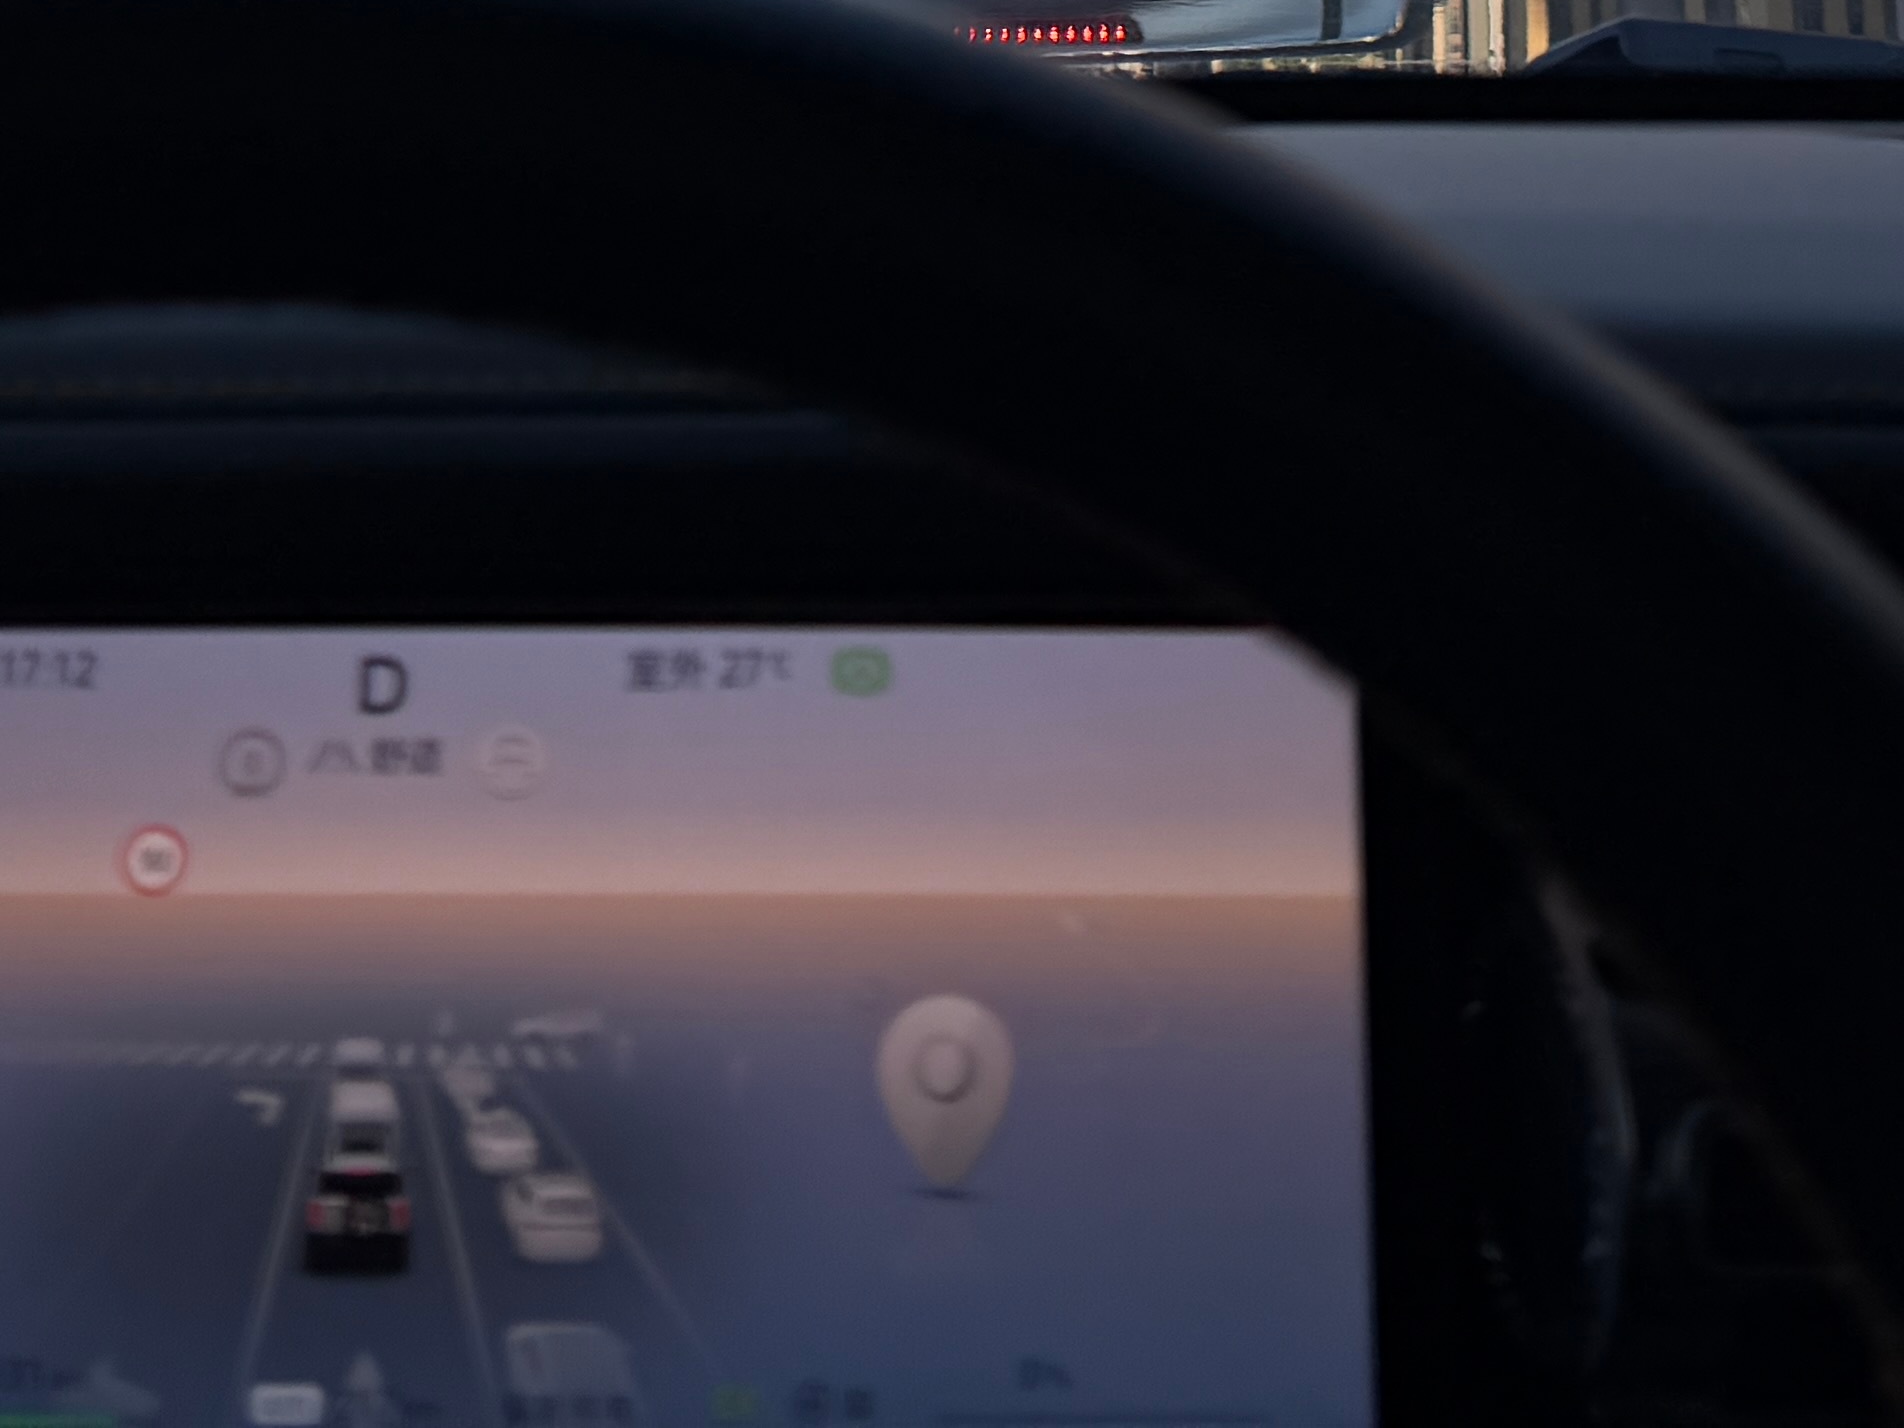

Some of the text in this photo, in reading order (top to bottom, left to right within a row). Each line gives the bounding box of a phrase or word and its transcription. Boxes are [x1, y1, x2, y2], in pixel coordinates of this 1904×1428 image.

[0, 649, 99, 690] 17:12
[355, 654, 410, 717] D
[624, 649, 704, 692] 室外
